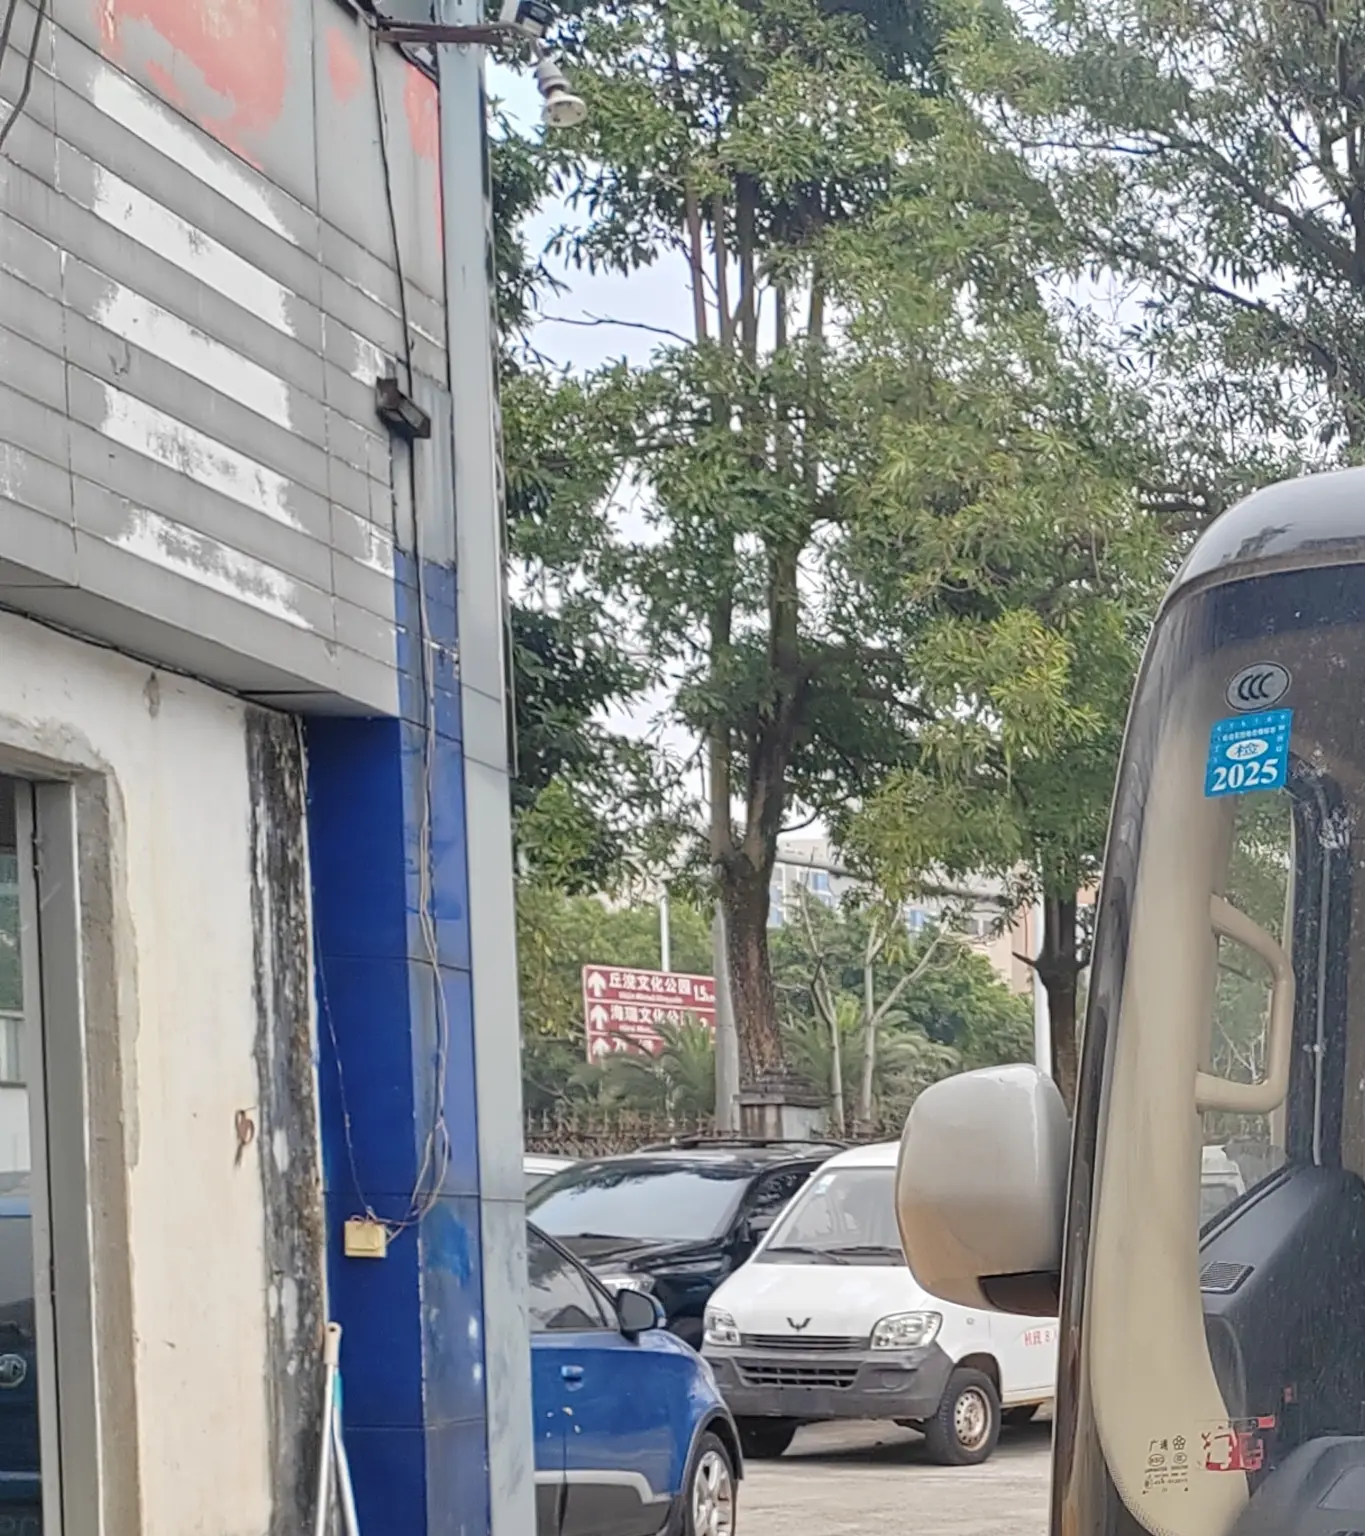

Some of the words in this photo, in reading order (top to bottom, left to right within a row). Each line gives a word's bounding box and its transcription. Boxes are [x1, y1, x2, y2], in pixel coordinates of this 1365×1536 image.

[1211, 758, 1279, 791] 2025
[610, 1003, 685, 1026] 海瑞文化公
